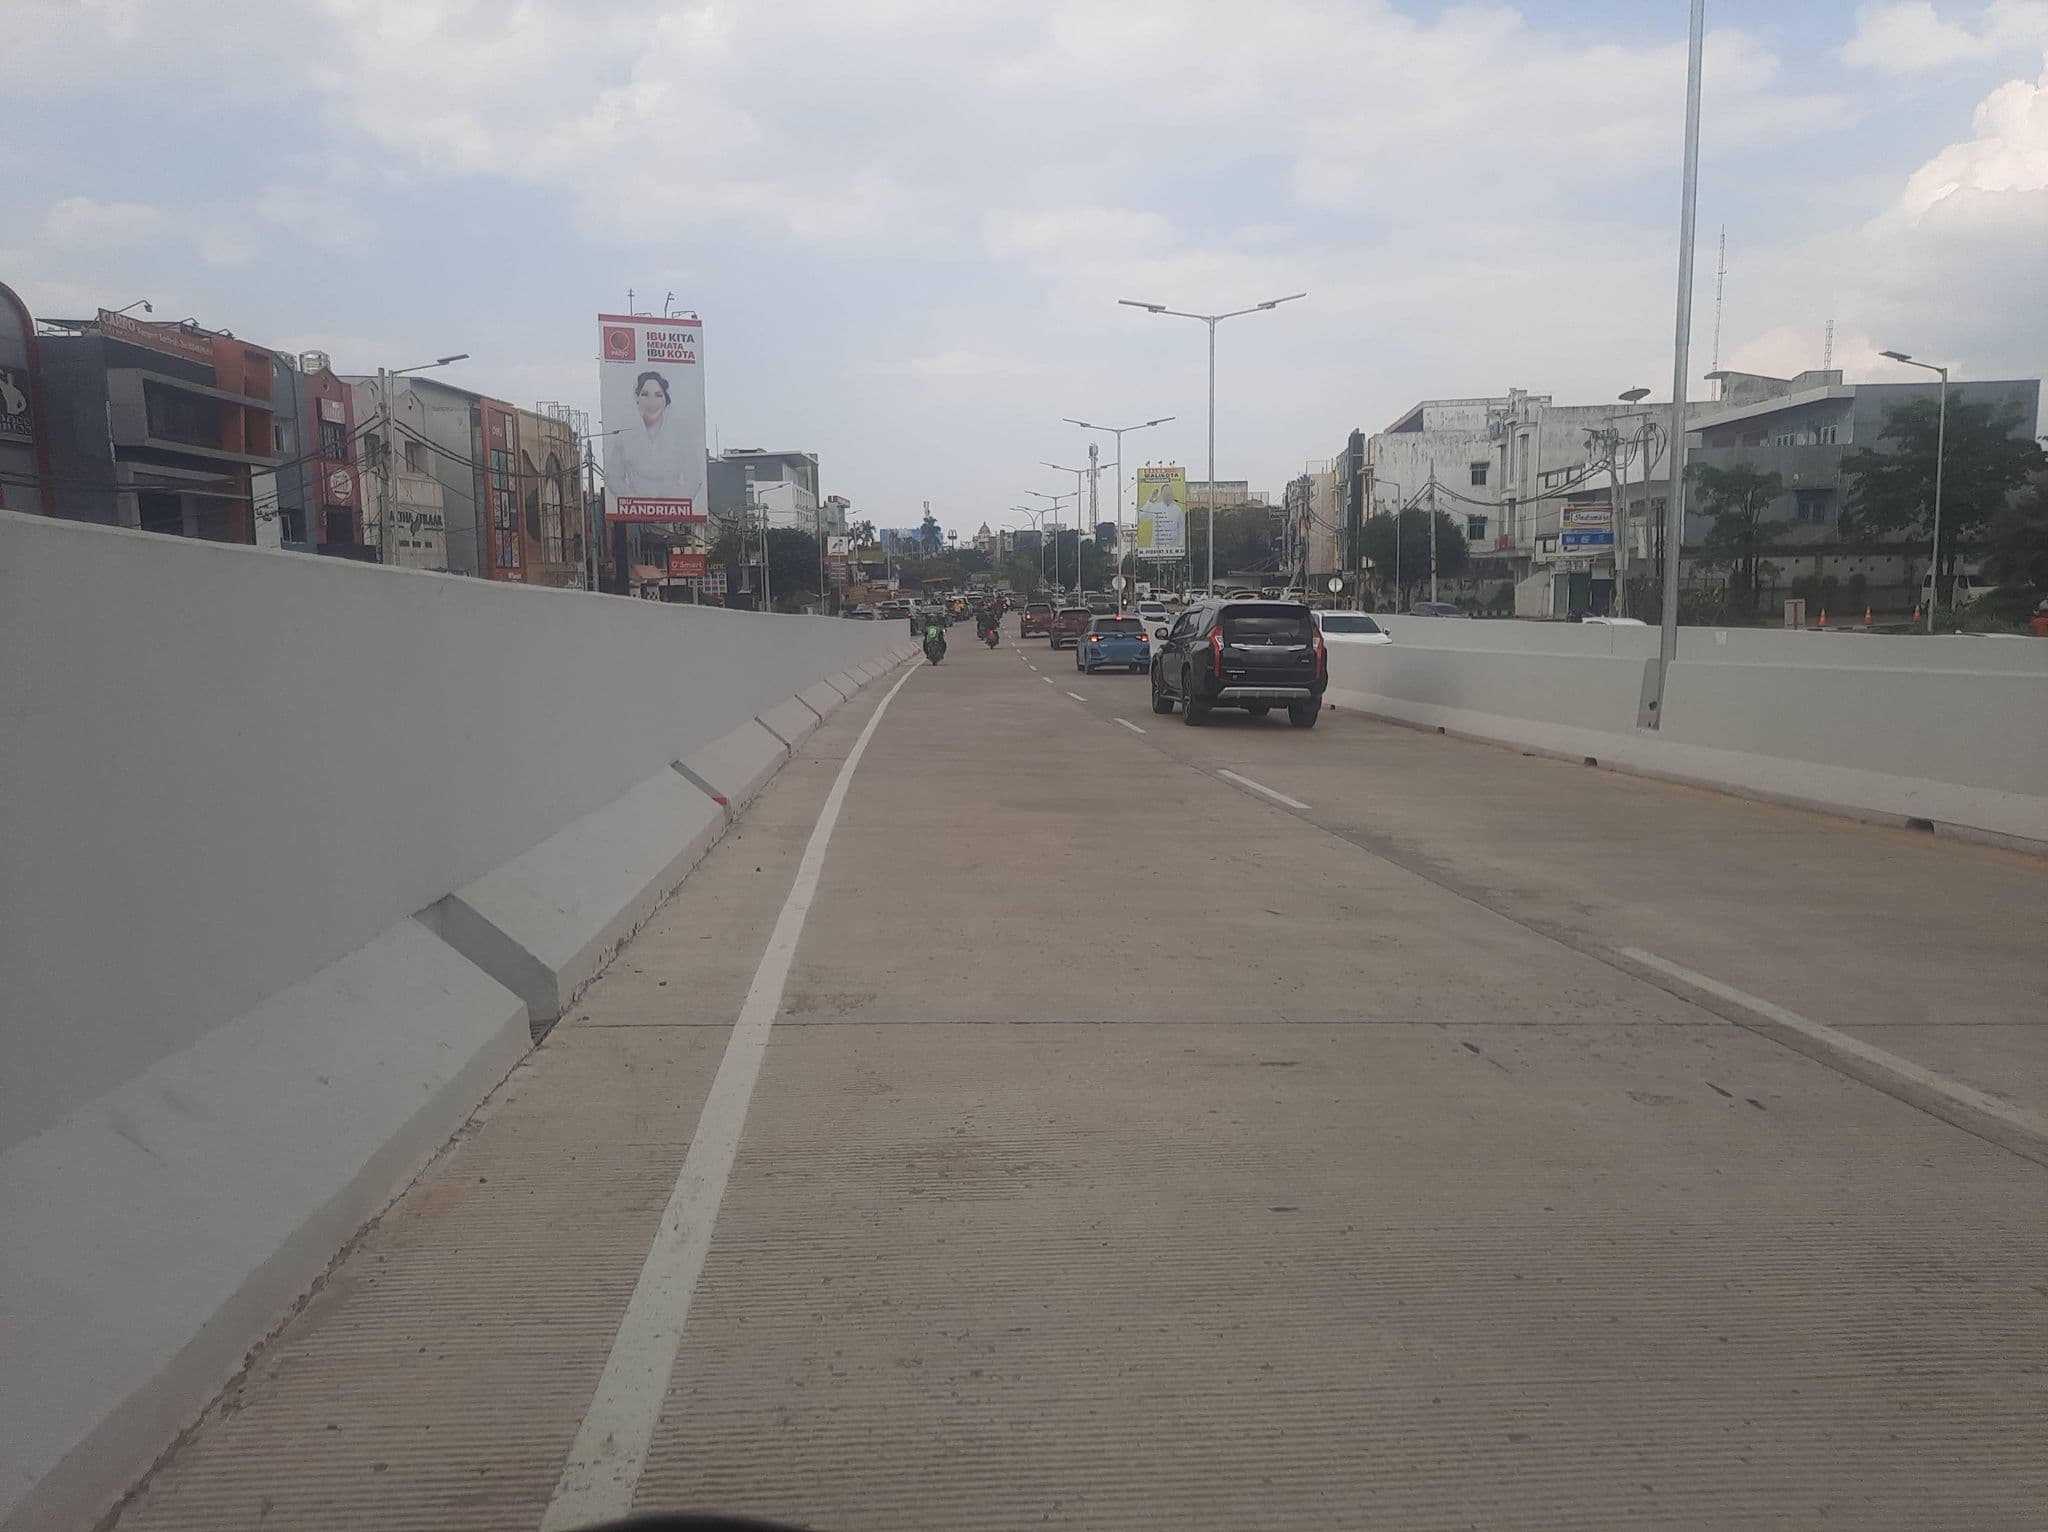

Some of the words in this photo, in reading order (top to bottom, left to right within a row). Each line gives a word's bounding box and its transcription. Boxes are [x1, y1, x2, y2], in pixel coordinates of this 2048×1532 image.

[646, 331, 666, 341] IBU
[668, 333, 695, 343] KITA
[647, 341, 684, 350] MENATA
[647, 349, 665, 357] IBU
[667, 350, 696, 359] KOTA
[619, 504, 691, 516] NANDRIANI
